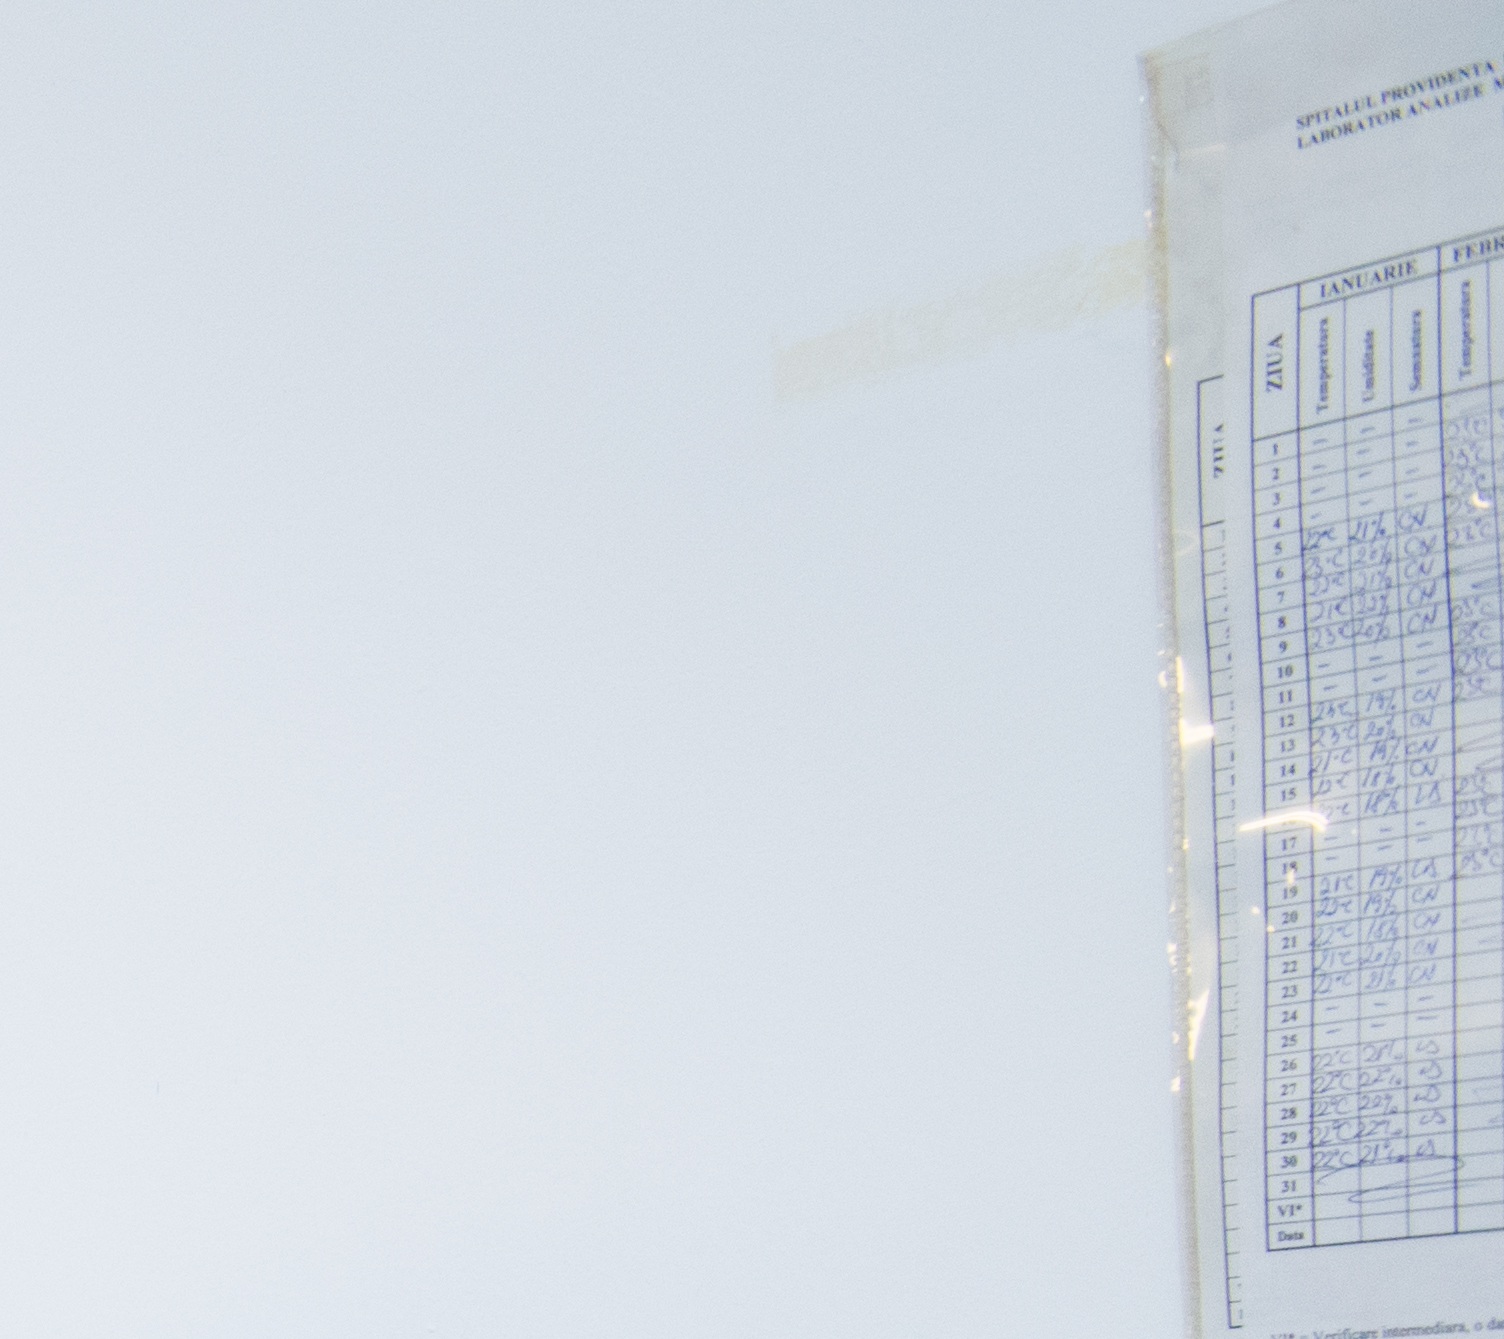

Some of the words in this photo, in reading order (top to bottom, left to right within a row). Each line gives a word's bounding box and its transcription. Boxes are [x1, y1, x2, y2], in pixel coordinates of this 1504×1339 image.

[1296, 95, 1377, 129] SPITALUL
[1381, 59, 1498, 105] PROVIDENTA
[1297, 106, 1405, 149] LABORATOR
[1409, 82, 1486, 116] ANALIZE
[1320, 258, 1419, 299] IANUARIE
[1266, 333, 1284, 393] ZIUA
[1316, 317, 1332, 415] Temperatura
[1277, 1230, 1305, 1242] Data
